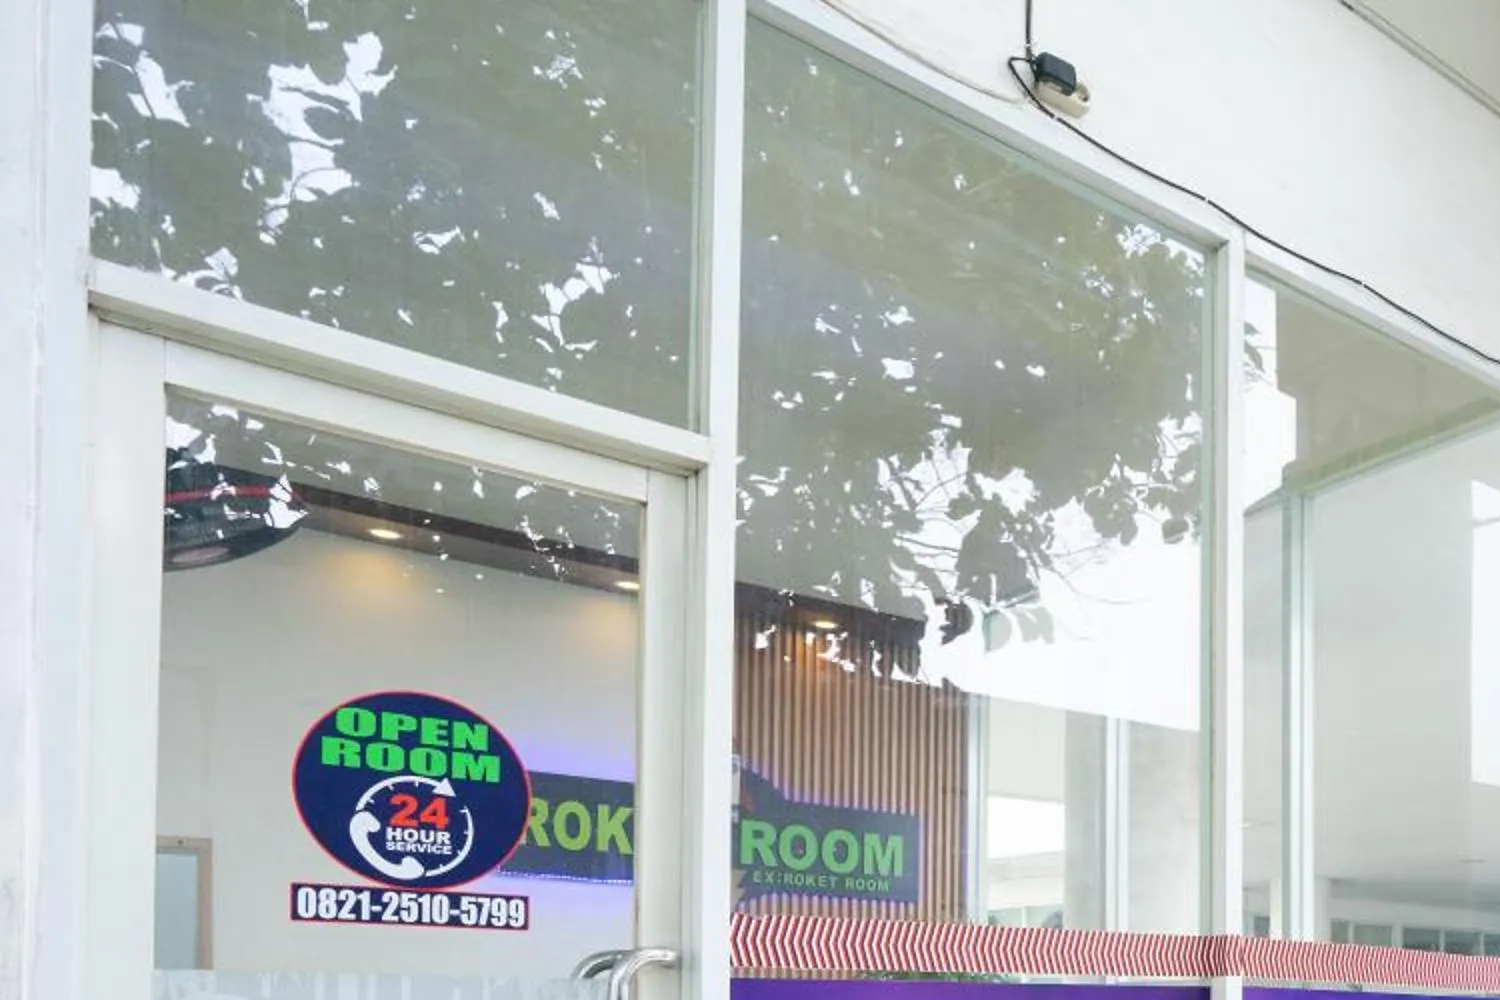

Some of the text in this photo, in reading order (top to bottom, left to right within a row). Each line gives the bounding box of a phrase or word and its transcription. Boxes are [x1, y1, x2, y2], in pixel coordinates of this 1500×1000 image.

[335, 706, 489, 751] OPEN
[320, 736, 502, 783] ROOM
[388, 794, 450, 829] 24
[385, 827, 452, 845] HOUR
[385, 841, 453, 855] SERVICE
[522, 797, 905, 877] ROK ROOM
[845, 878, 890, 892] ROOM
[296, 887, 526, 928] 0821-2510-5799
